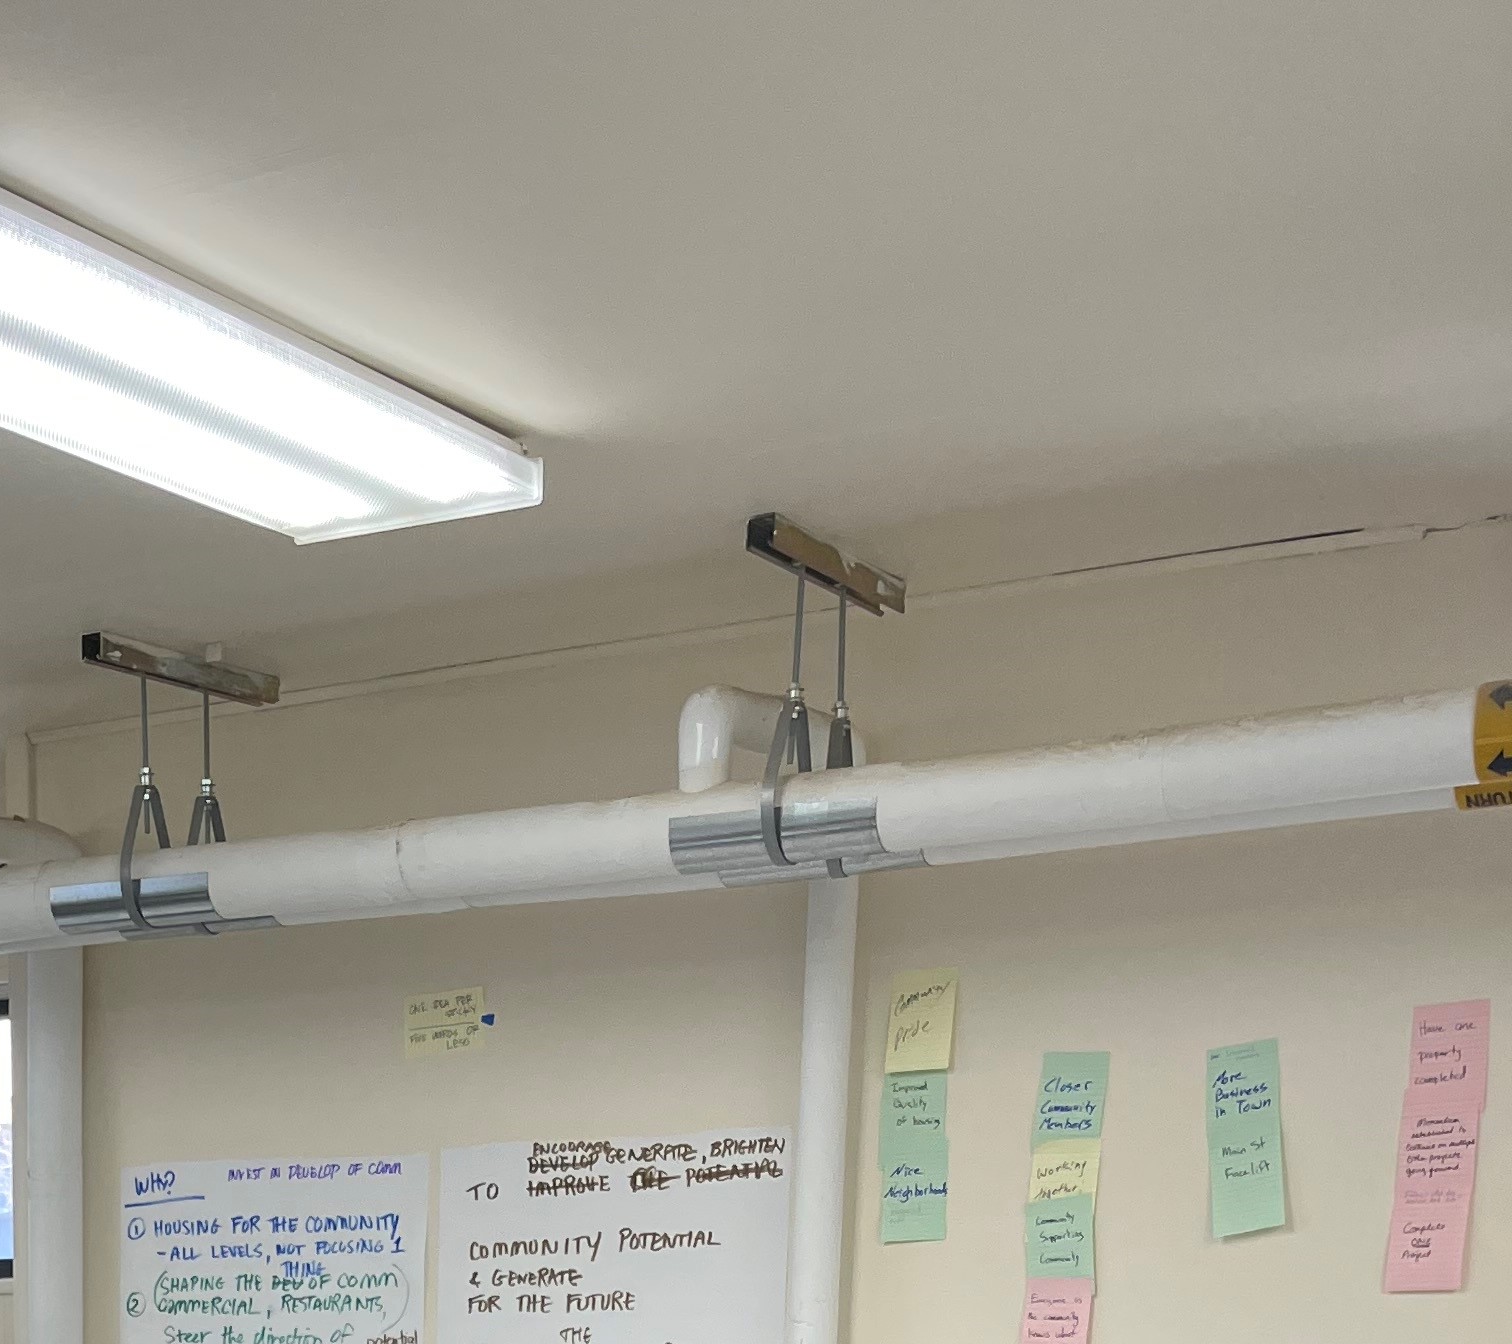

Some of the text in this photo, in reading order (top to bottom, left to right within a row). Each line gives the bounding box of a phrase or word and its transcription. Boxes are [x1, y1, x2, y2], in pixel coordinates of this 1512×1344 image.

[1044, 1077, 1092, 1093] Closer
[1212, 1070, 1247, 1088] More
[1216, 1083, 1268, 1102] Business
[1236, 1099, 1271, 1114] Town
[709, 1137, 786, 1159] BRIGHTEN
[134, 1170, 175, 1195] WHY?
[228, 1166, 265, 1182] INVEST
[347, 1162, 363, 1176] OF
[890, 1163, 924, 1177] Nice
[1037, 1161, 1087, 1179] Working
[466, 1182, 500, 1201] TO
[154, 1213, 400, 1240] HOUSING FOR THE COMMUNITY
[170, 1246, 201, 1261] ALL
[275, 1244, 306, 1257] NOT
[316, 1240, 384, 1255] FOCUSING
[469, 1227, 722, 1262] COMMUNITY POTENTIAL
[280, 1261, 326, 1278] THING
[491, 1267, 584, 1288] GENERATE
[235, 1273, 262, 1291] THE
[308, 1274, 331, 1290] OF
[467, 1290, 636, 1314] FOR THE FUTURE
[164, 1325, 212, 1344] Steer
[221, 1323, 245, 1344] the
[329, 1323, 355, 1343] of
[560, 1327, 592, 1344] THE
